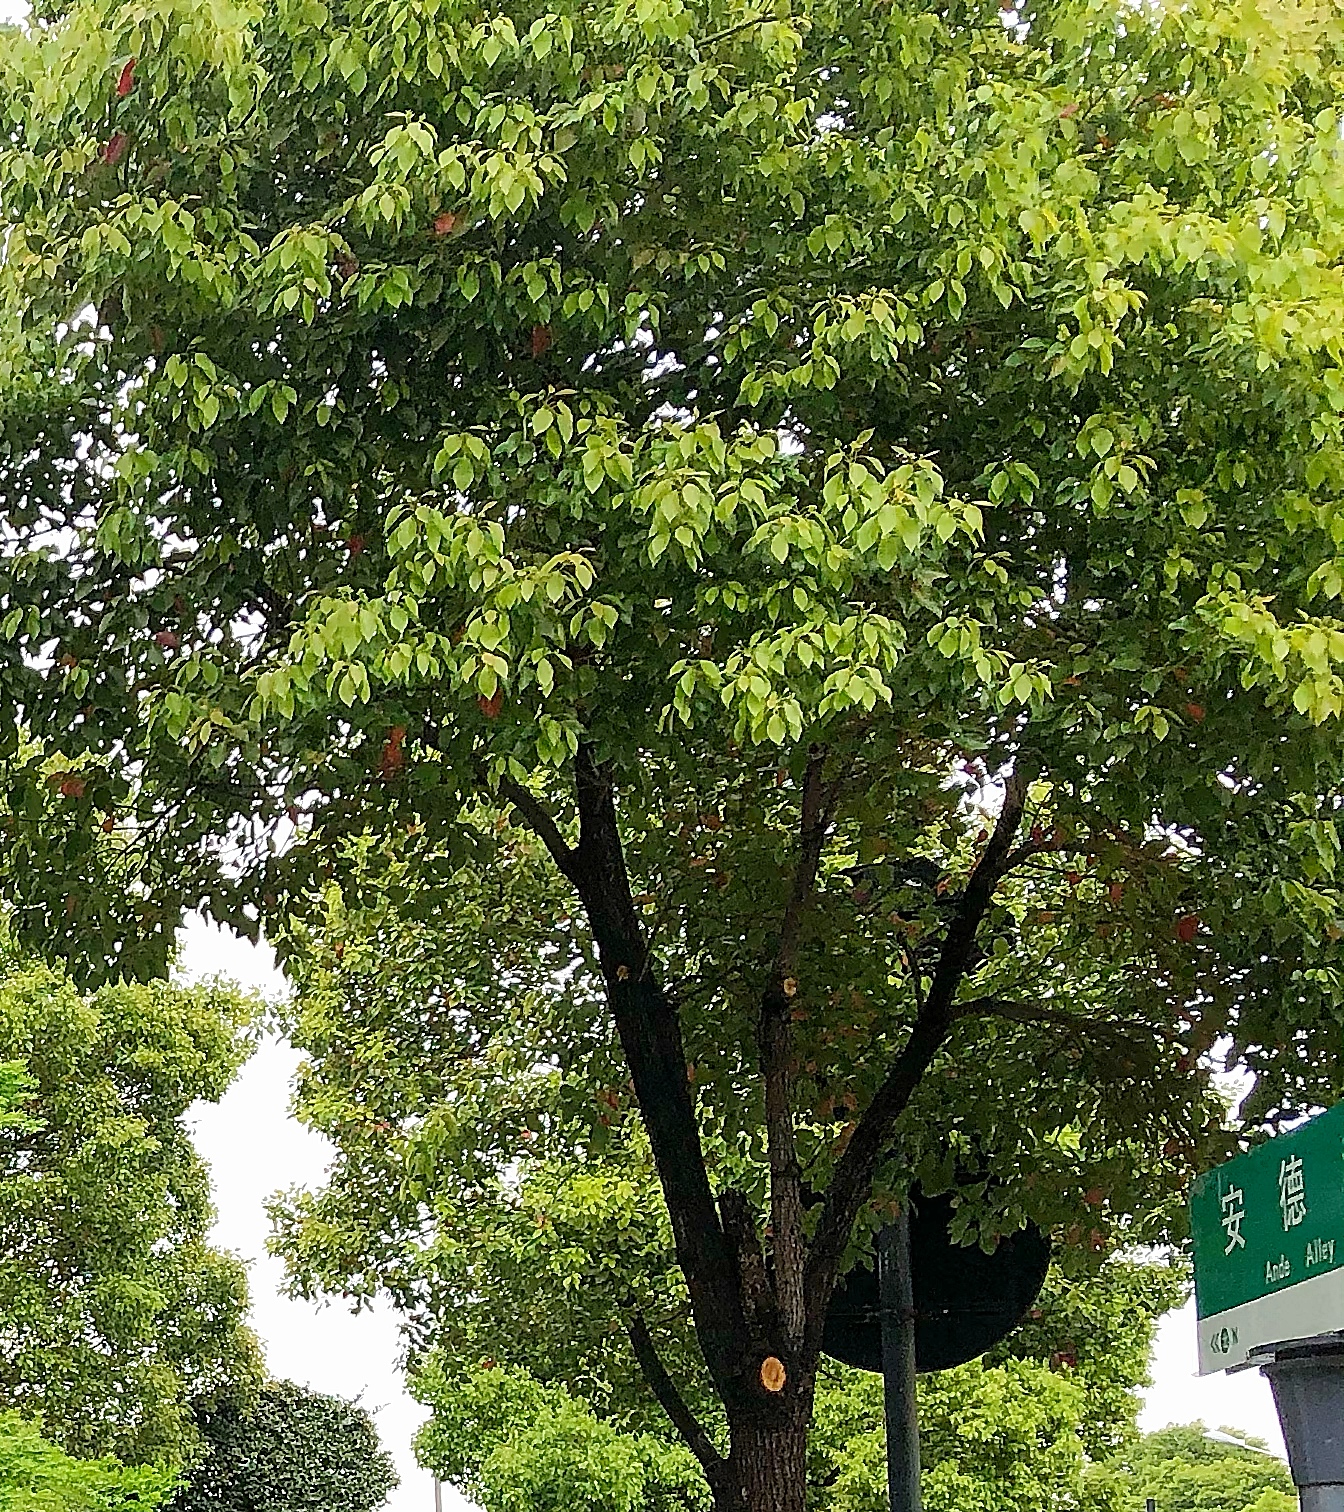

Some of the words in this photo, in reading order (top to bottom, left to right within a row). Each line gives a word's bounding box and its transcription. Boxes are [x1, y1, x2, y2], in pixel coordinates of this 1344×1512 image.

[1221, 1153, 1344, 1256] 安德
[1265, 1255, 1291, 1284] Ande
[1306, 1237, 1335, 1268] Alley
